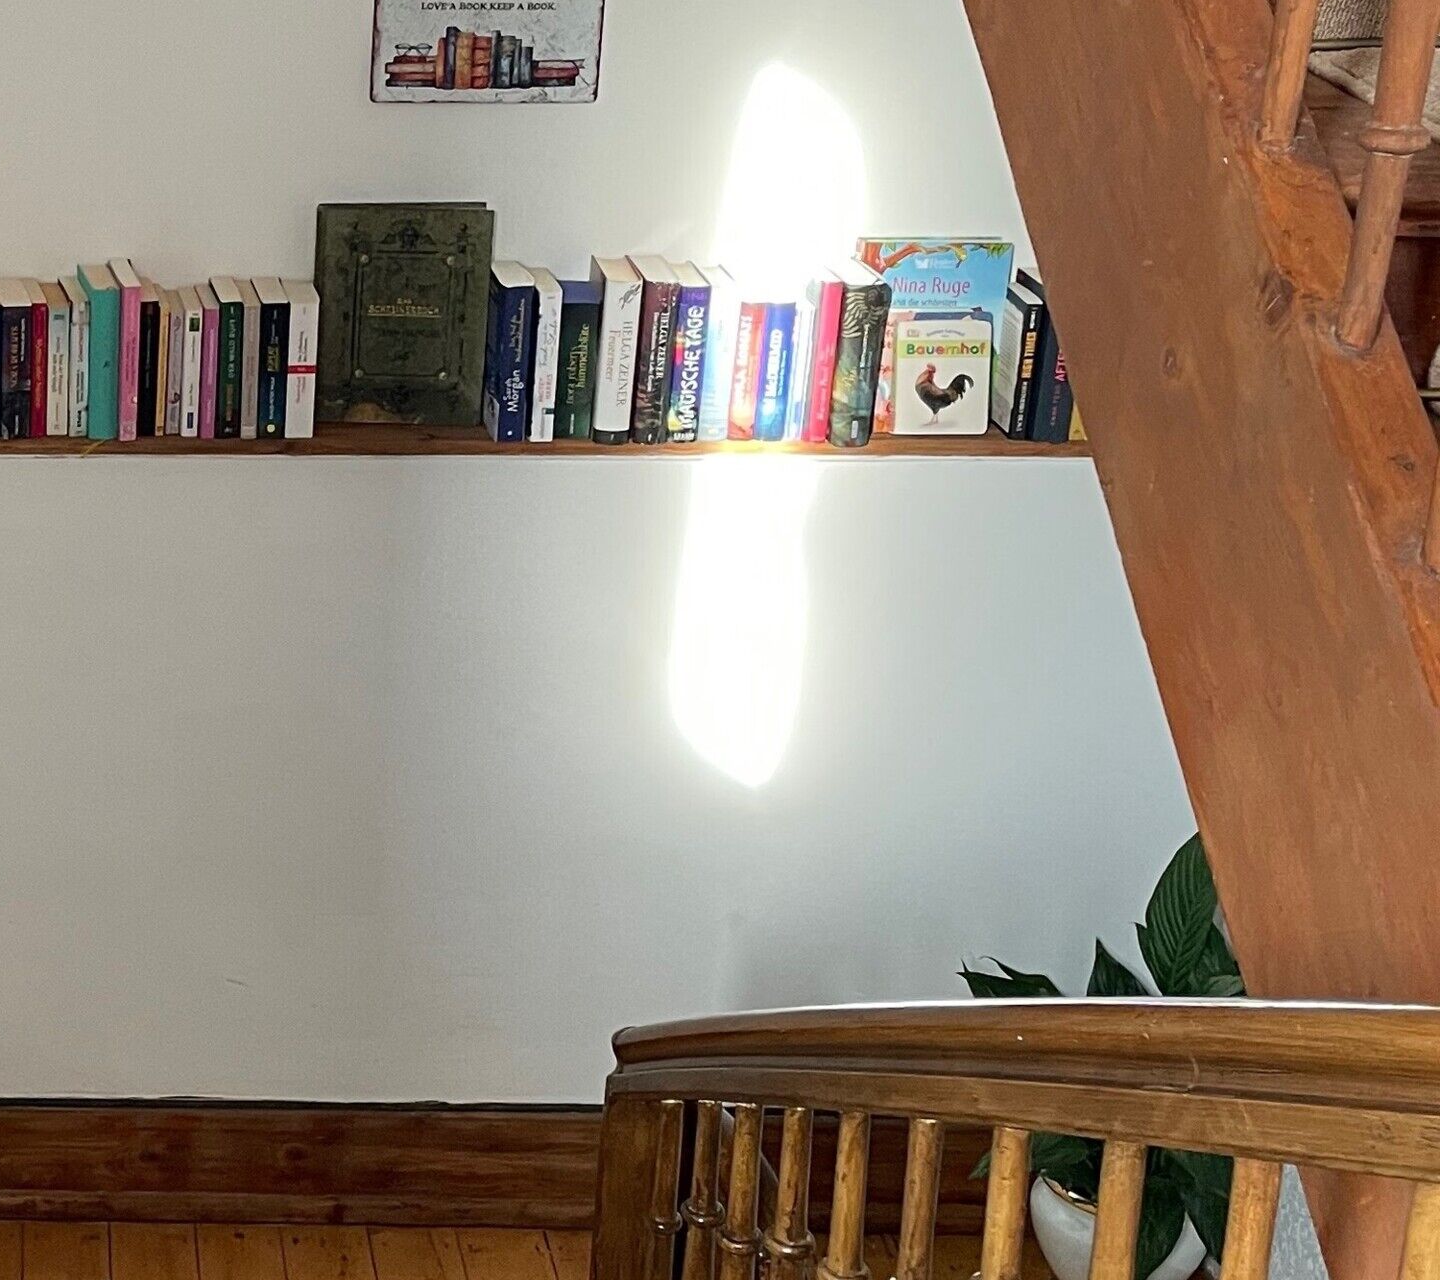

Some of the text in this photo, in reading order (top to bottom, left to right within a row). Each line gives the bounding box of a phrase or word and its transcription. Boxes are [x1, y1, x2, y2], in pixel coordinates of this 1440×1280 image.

[421, 2, 447, 11] LOVE
[449, 2, 456, 11] A
[490, 2, 515, 11] KEEP
[517, 2, 525, 11] A
[892, 276, 971, 297] Nina Ruge
[685, 304, 705, 348] TAGE
[616, 321, 633, 407] HELGA ZEINER
[655, 312, 669, 379] HELGA ZEINER
[906, 342, 986, 355] Bauernhof
[1055, 349, 1067, 382] AFTE
[503, 378, 512, 400] Sarah
[507, 369, 524, 412] Morgan
[676, 349, 702, 429] MAGISCHE
